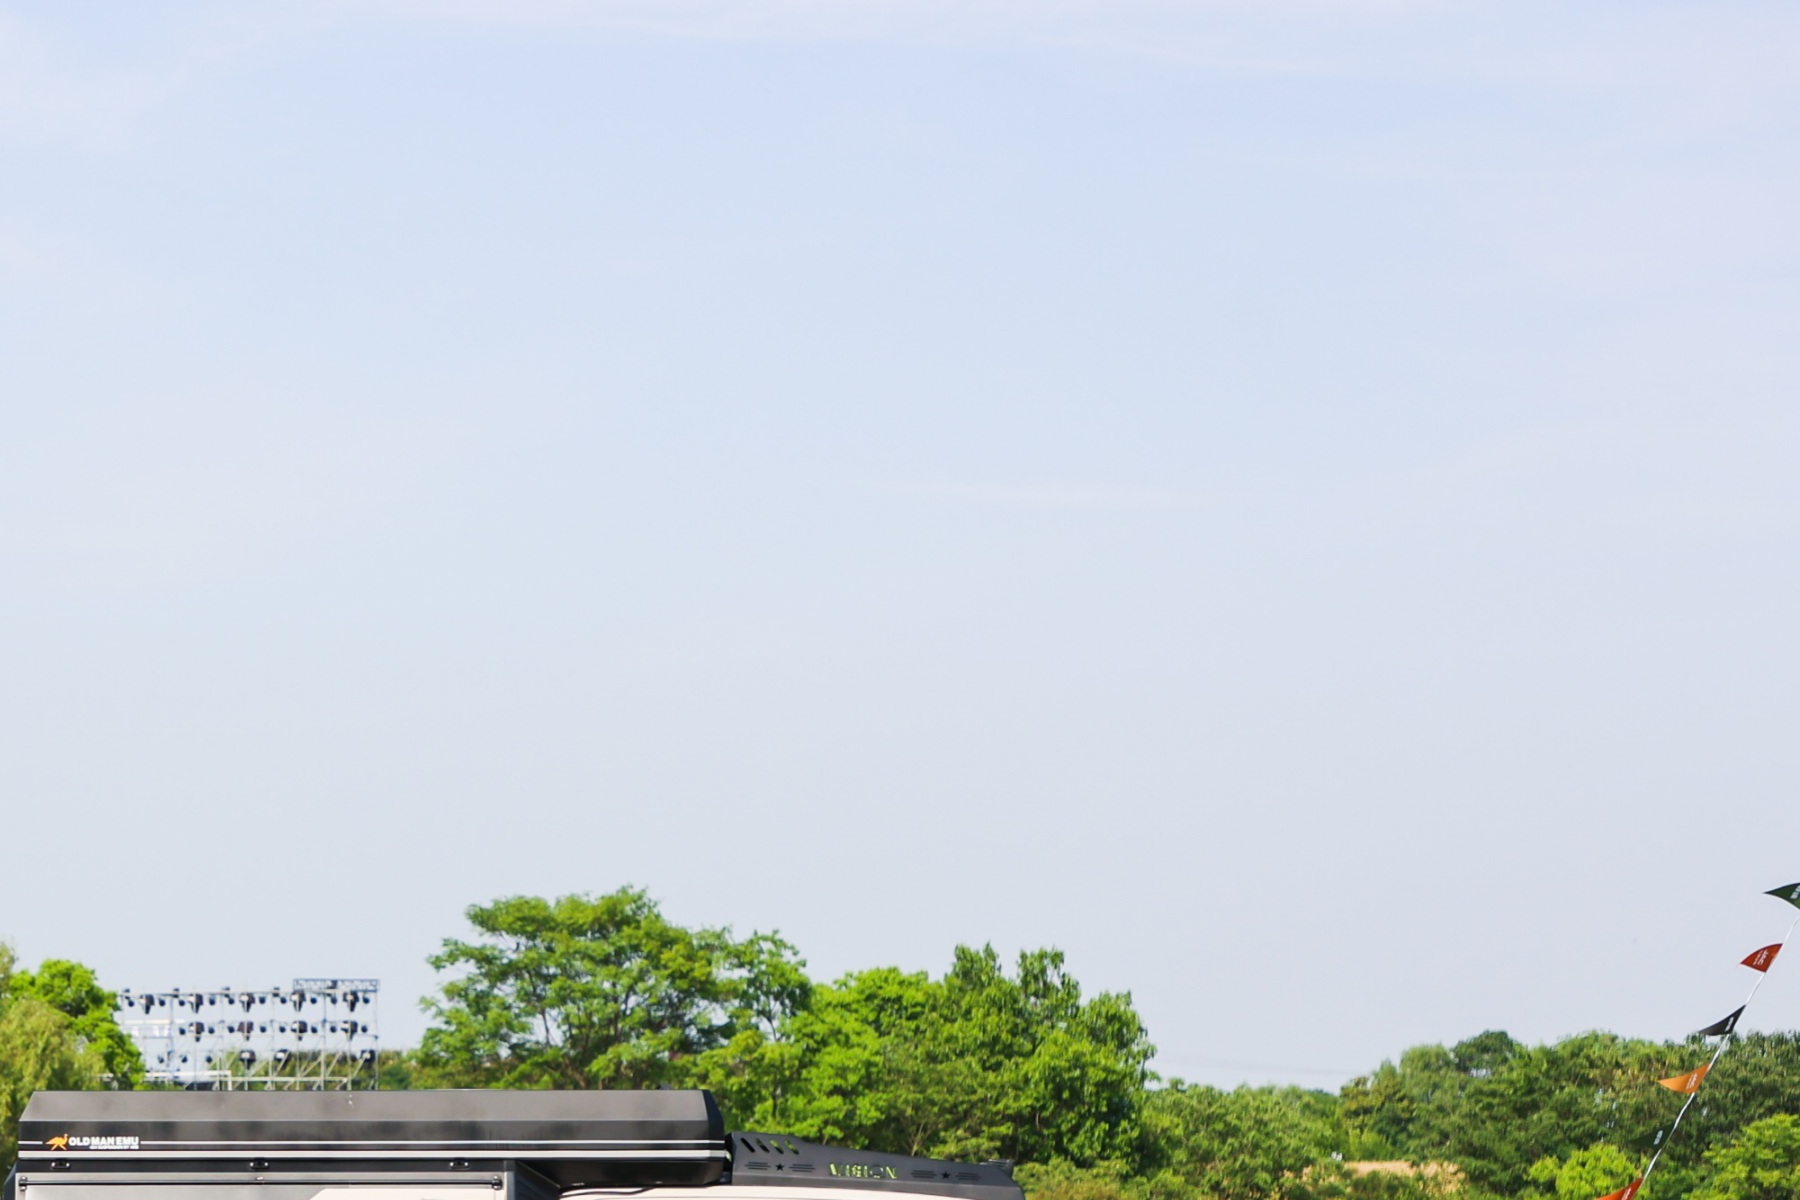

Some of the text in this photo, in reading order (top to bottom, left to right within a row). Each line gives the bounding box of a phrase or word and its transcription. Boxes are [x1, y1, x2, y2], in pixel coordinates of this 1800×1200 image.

[68, 1136, 139, 1146] OLD MAN EMU
